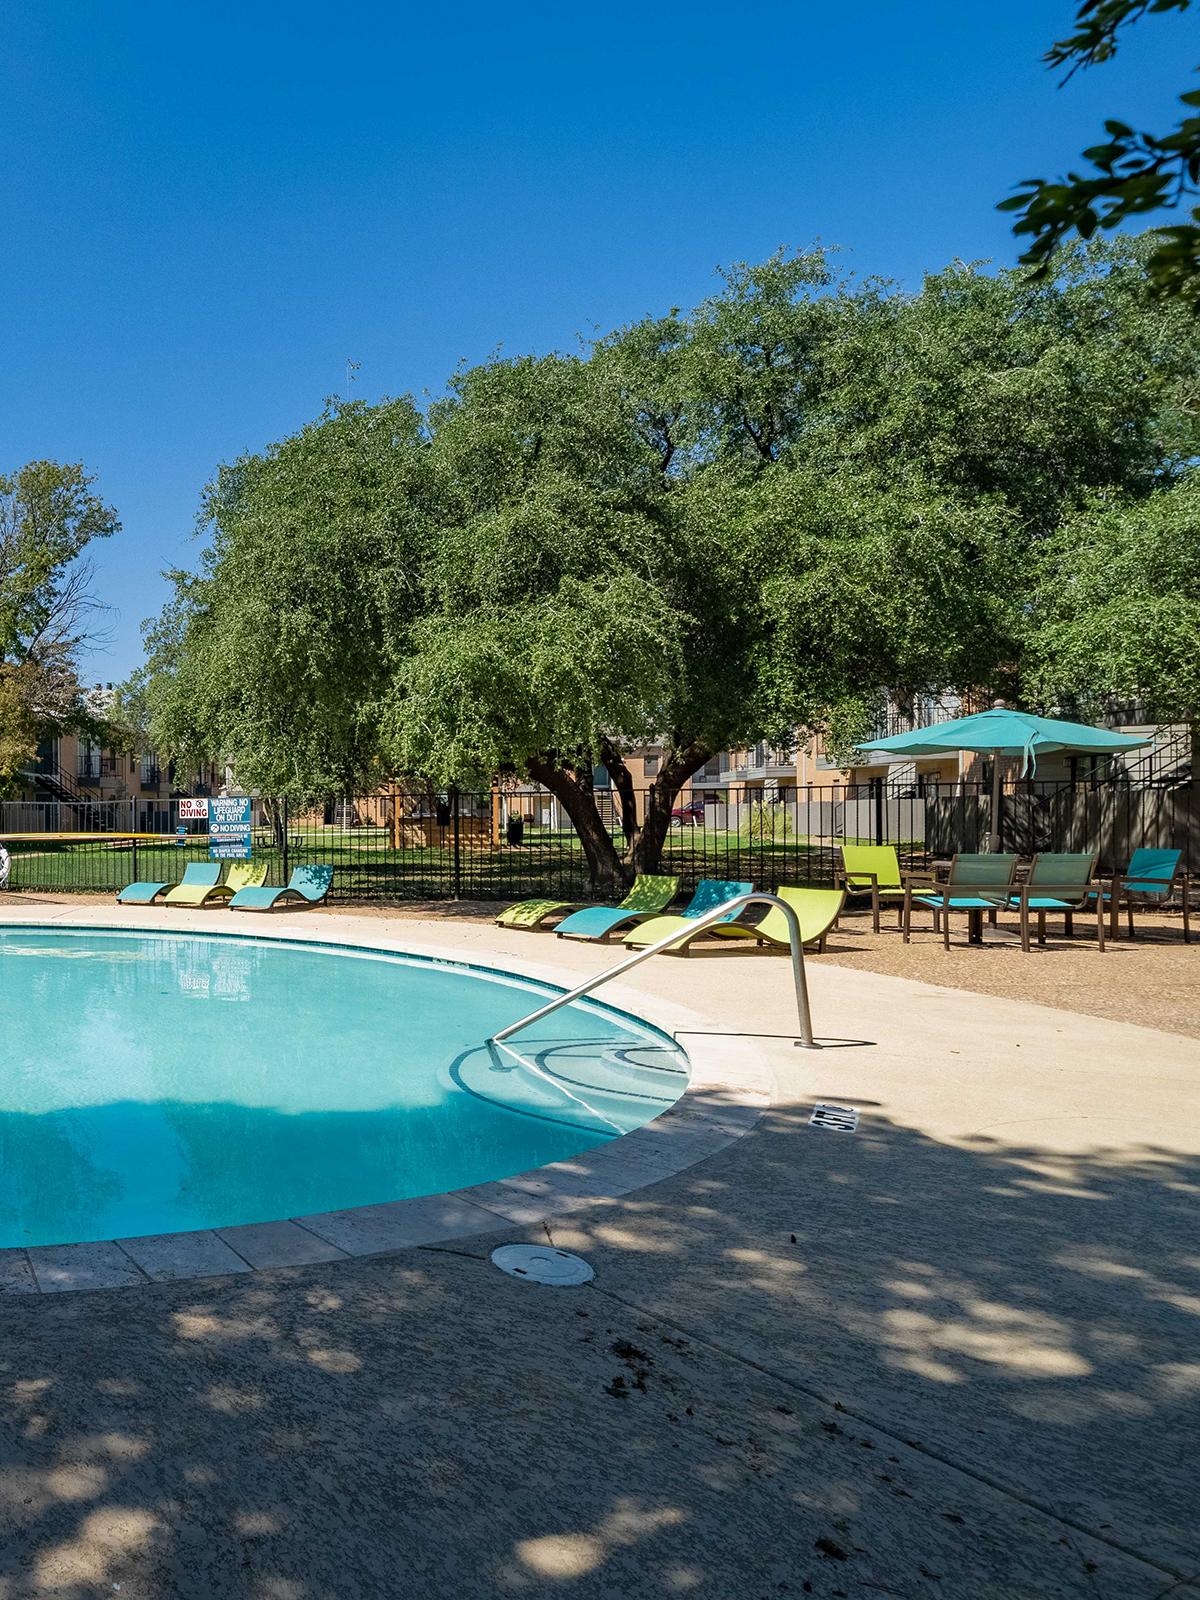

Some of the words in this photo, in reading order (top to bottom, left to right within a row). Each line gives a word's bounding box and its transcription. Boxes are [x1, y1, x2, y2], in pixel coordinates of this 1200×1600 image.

[211, 799, 237, 807] WARNING
[239, 798, 248, 806] NO
[227, 813, 242, 821] DUTY
[220, 824, 229, 832] NO
[230, 824, 250, 832] DIVING
